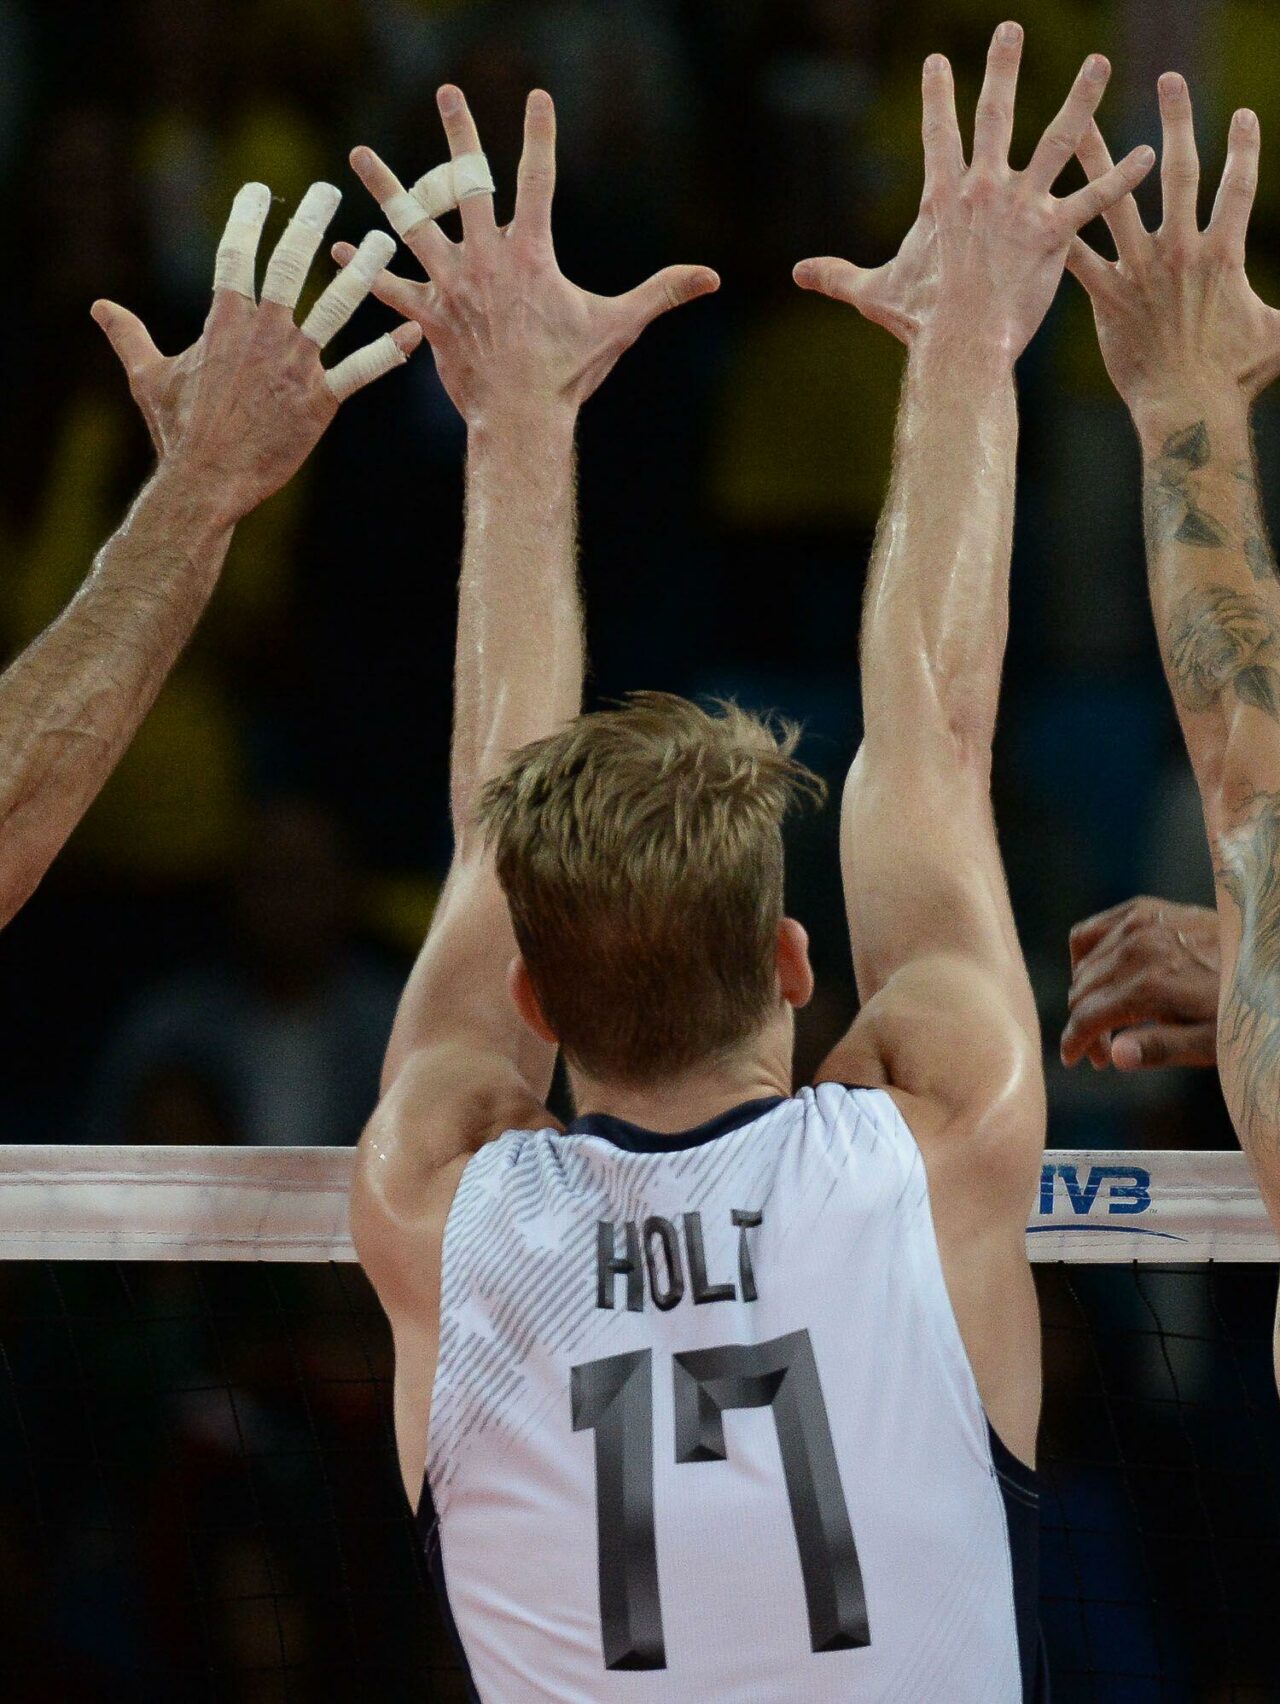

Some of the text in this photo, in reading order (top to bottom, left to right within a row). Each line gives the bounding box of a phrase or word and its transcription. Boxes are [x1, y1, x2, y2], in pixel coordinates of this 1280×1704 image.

[1040, 1164, 1152, 1214] IVB
[595, 1209, 763, 1312] HOLT
[570, 1328, 872, 1671] 17
